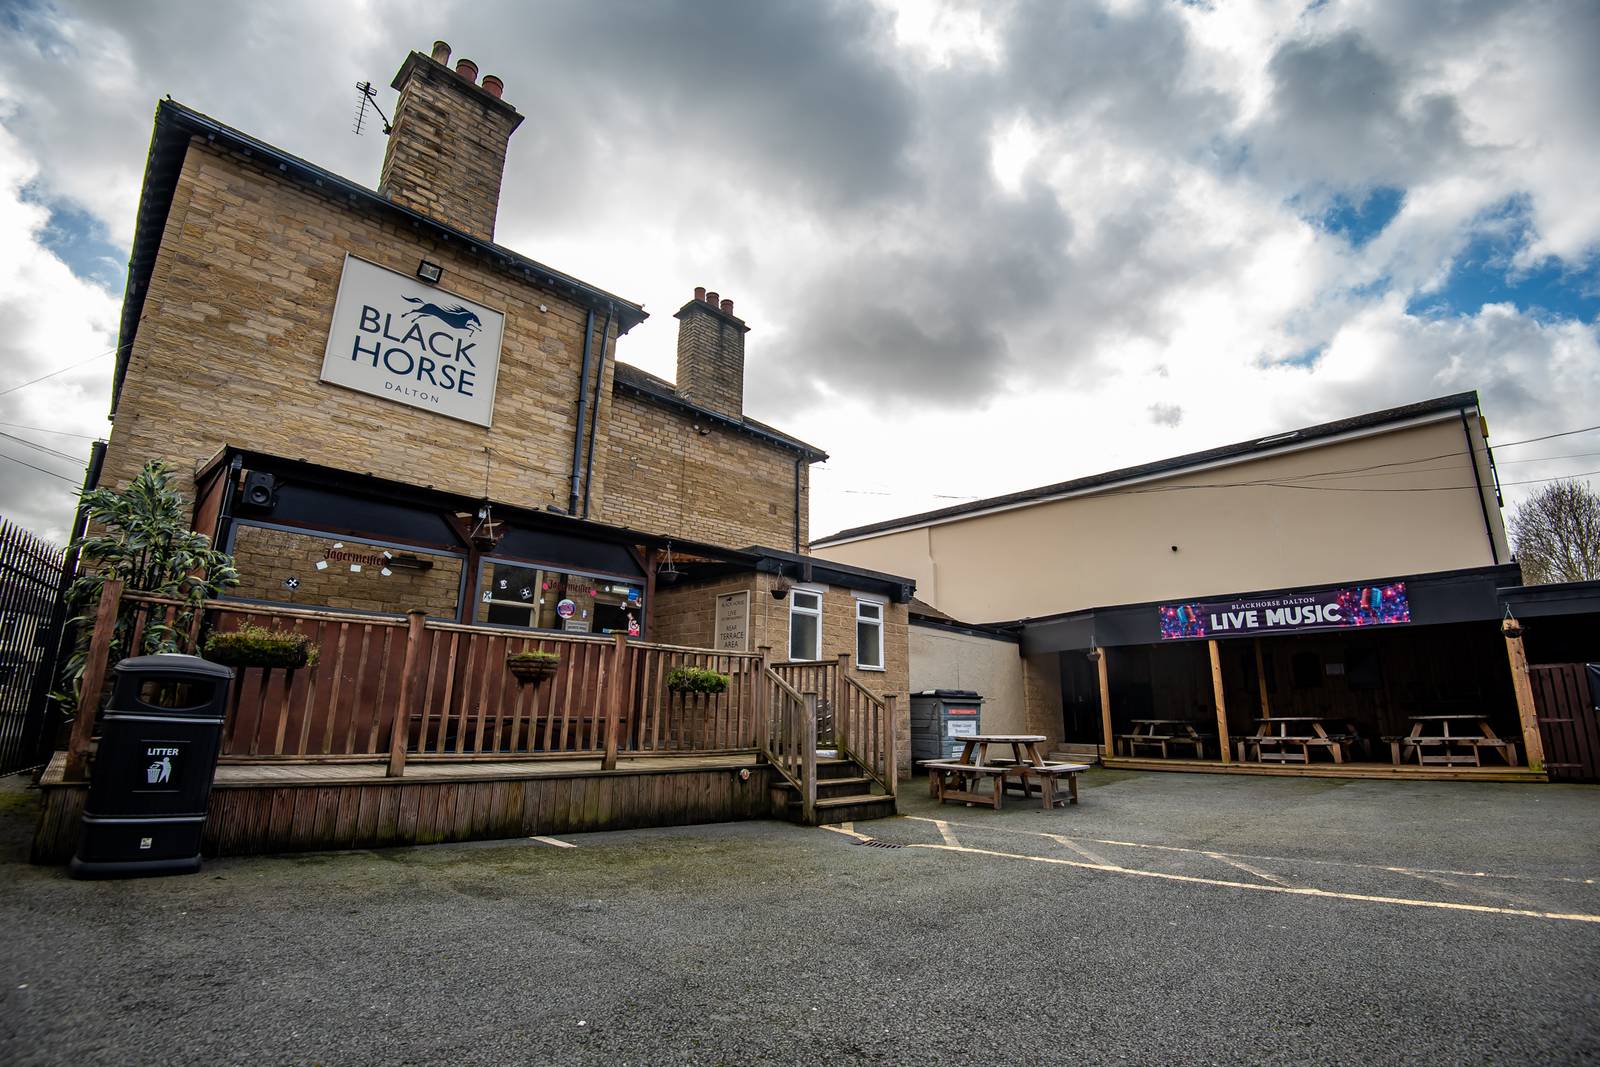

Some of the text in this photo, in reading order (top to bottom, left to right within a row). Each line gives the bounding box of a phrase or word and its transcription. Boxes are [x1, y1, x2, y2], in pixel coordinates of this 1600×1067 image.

[358, 304, 477, 368] BLACK
[351, 335, 476, 397] HORSE
[384, 381, 440, 404] DALTON
[1231, 596, 1315, 610] BLACKHORSE DALTON
[1210, 603, 1343, 631] LIVE MUSIC
[720, 631, 744, 640] TERRACE
[147, 747, 179, 756] LITTER
